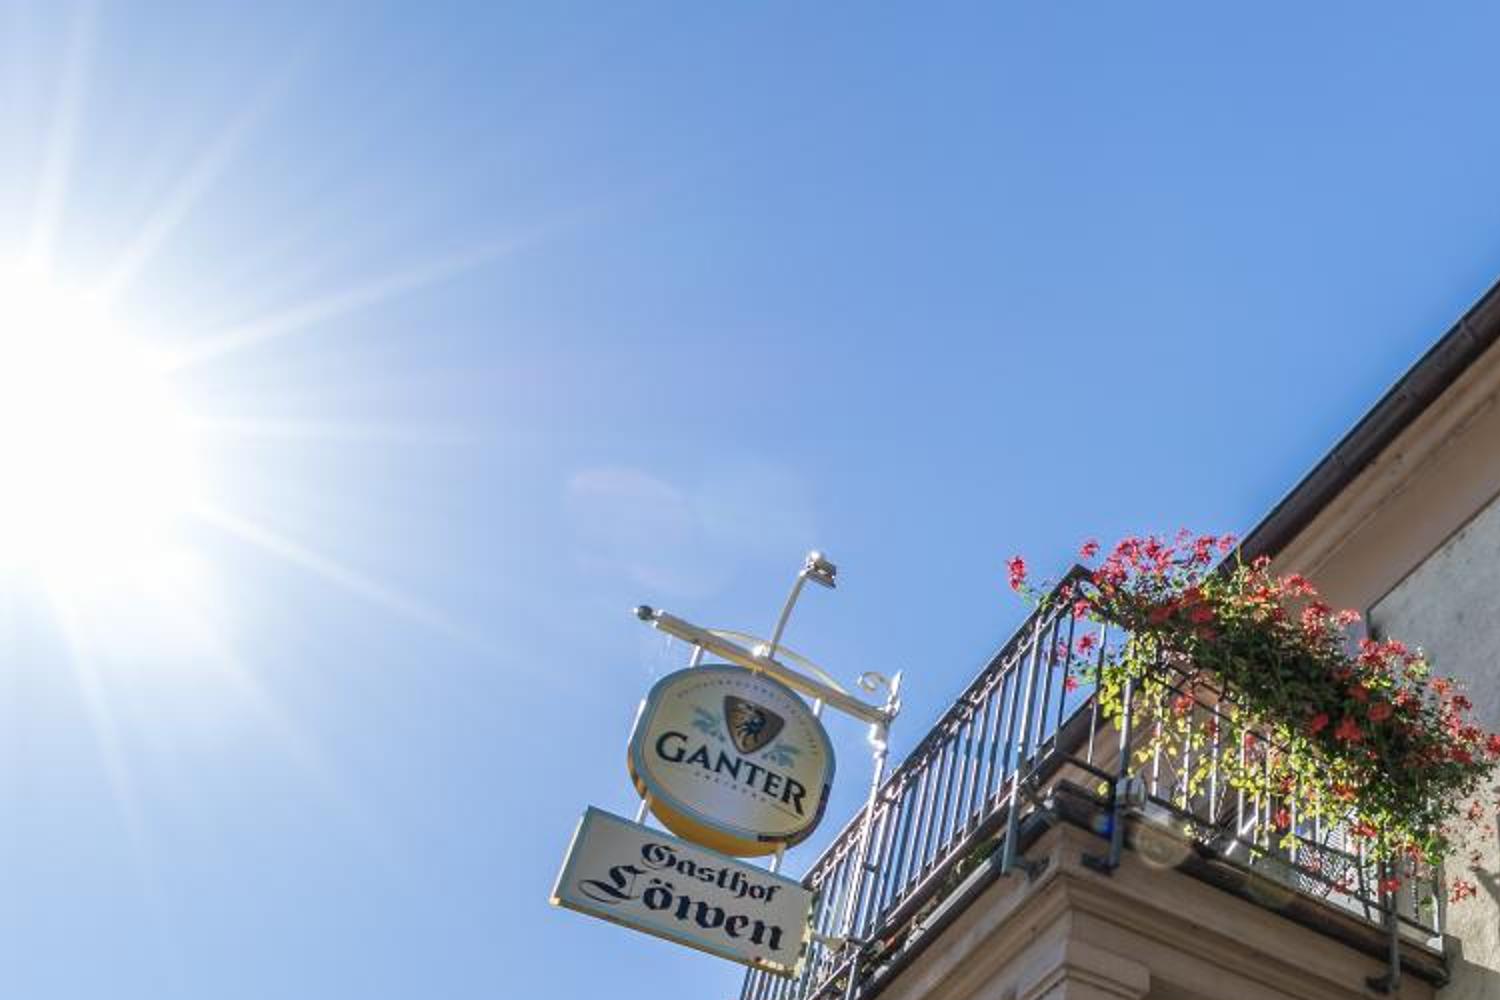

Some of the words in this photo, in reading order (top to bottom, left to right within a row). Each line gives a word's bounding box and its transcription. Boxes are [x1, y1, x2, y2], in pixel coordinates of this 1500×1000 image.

[655, 731, 807, 816] GANTER
[577, 864, 784, 951] Löwen
[640, 843, 782, 905] Gasthof
